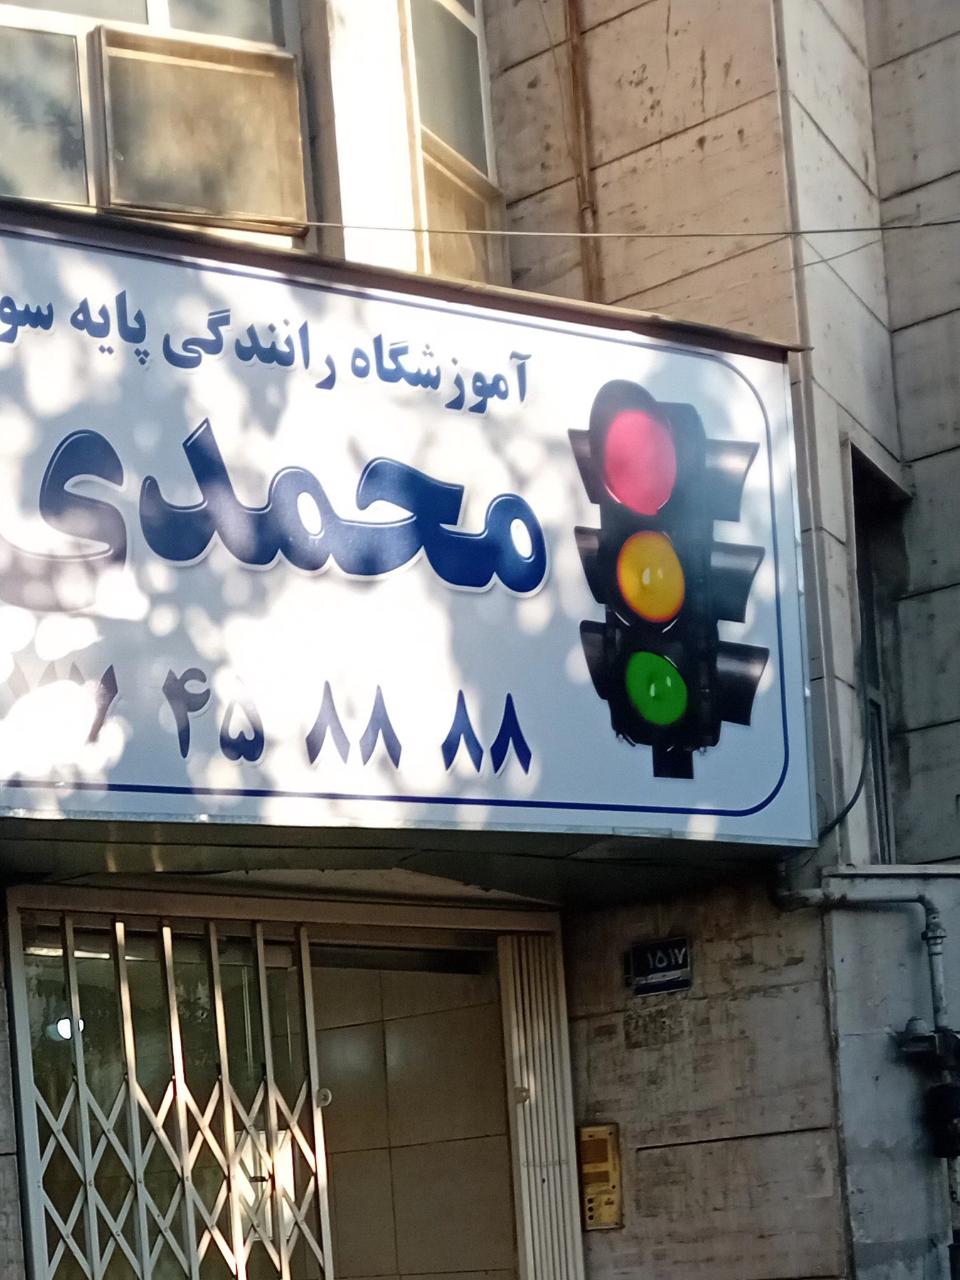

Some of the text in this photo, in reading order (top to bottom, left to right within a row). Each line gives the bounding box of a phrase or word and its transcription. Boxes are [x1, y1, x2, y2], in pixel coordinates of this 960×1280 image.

[69, 290, 150, 365] پایه
[162, 309, 337, 390] رانندگی
[351, 333, 532, 413] آموزشگاه
[161, 666, 265, 762] ۴۵
[305, 680, 402, 770] ۸۸
[441, 689, 533, 776] ۸۸
[646, 947, 687, 969] ۱۵۱۷
